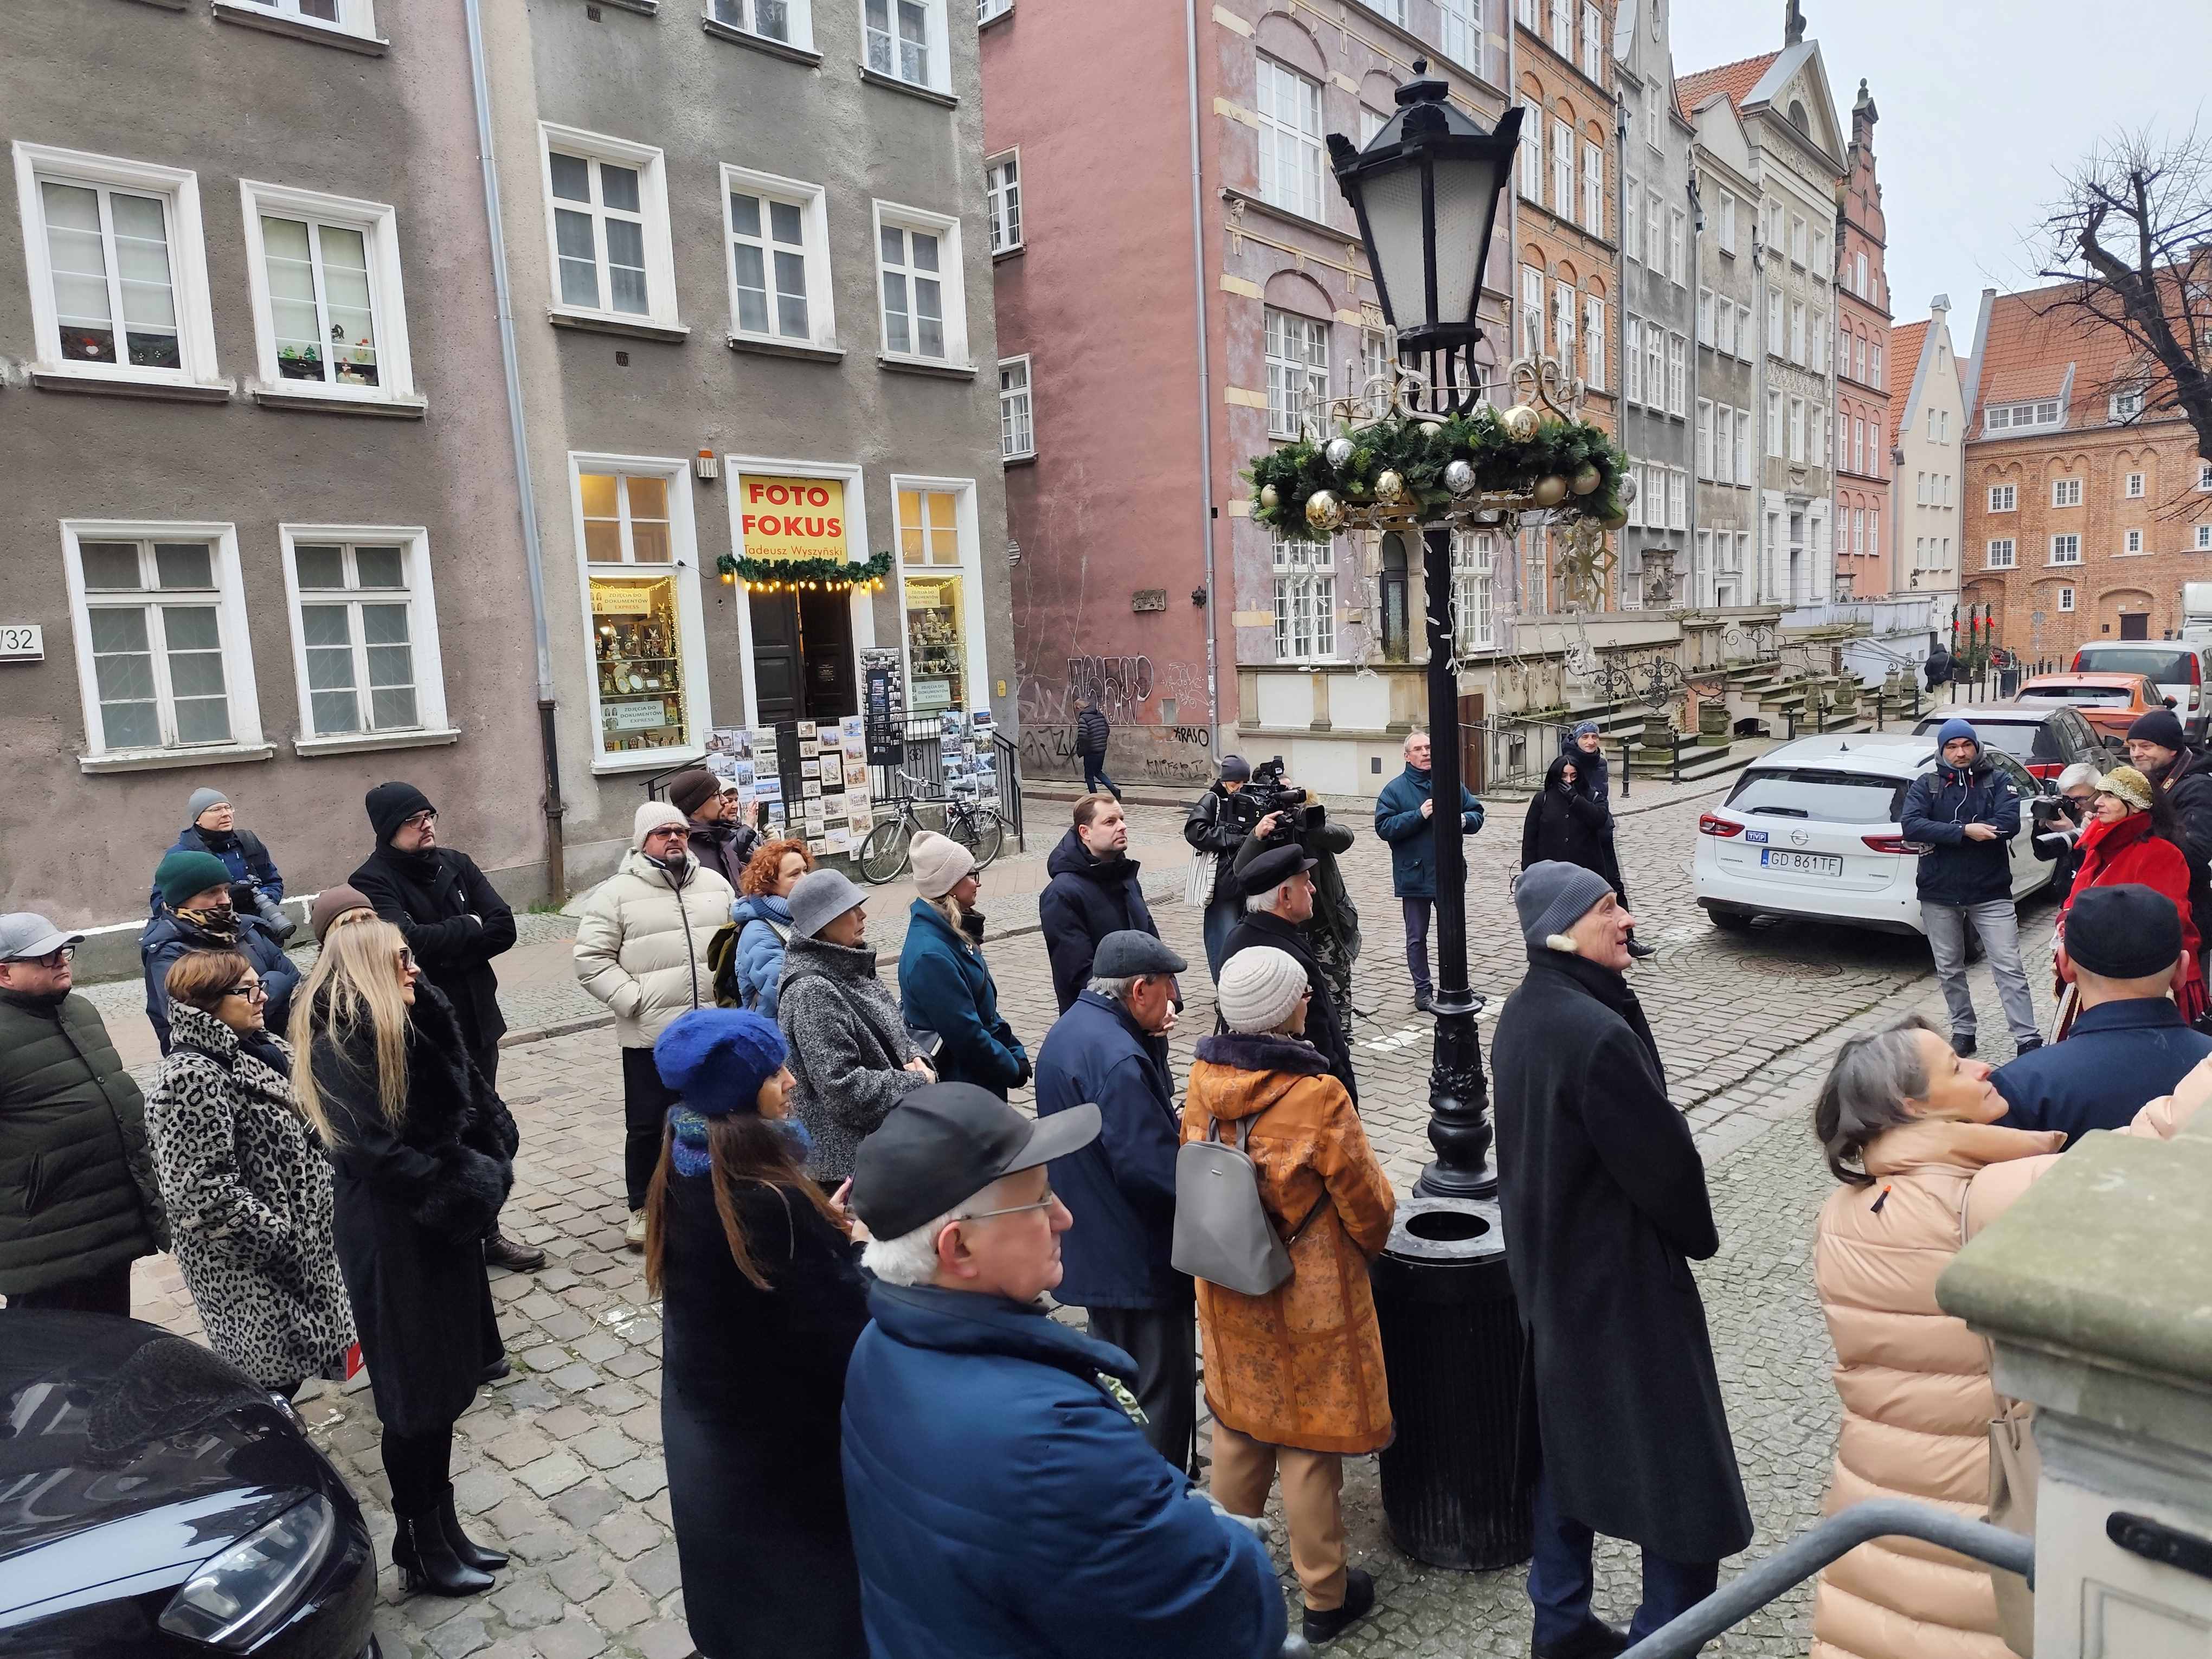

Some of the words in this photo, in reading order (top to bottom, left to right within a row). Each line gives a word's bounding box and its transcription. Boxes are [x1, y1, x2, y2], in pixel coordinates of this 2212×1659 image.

[749, 483, 829, 507] FOTO
[742, 514, 842, 538] FOKUS
[744, 544, 788, 555] Tadeusz
[1748, 832, 1765, 840] TVP
[1771, 853, 1789, 866] GD
[1794, 855, 1837, 871] 861TF
